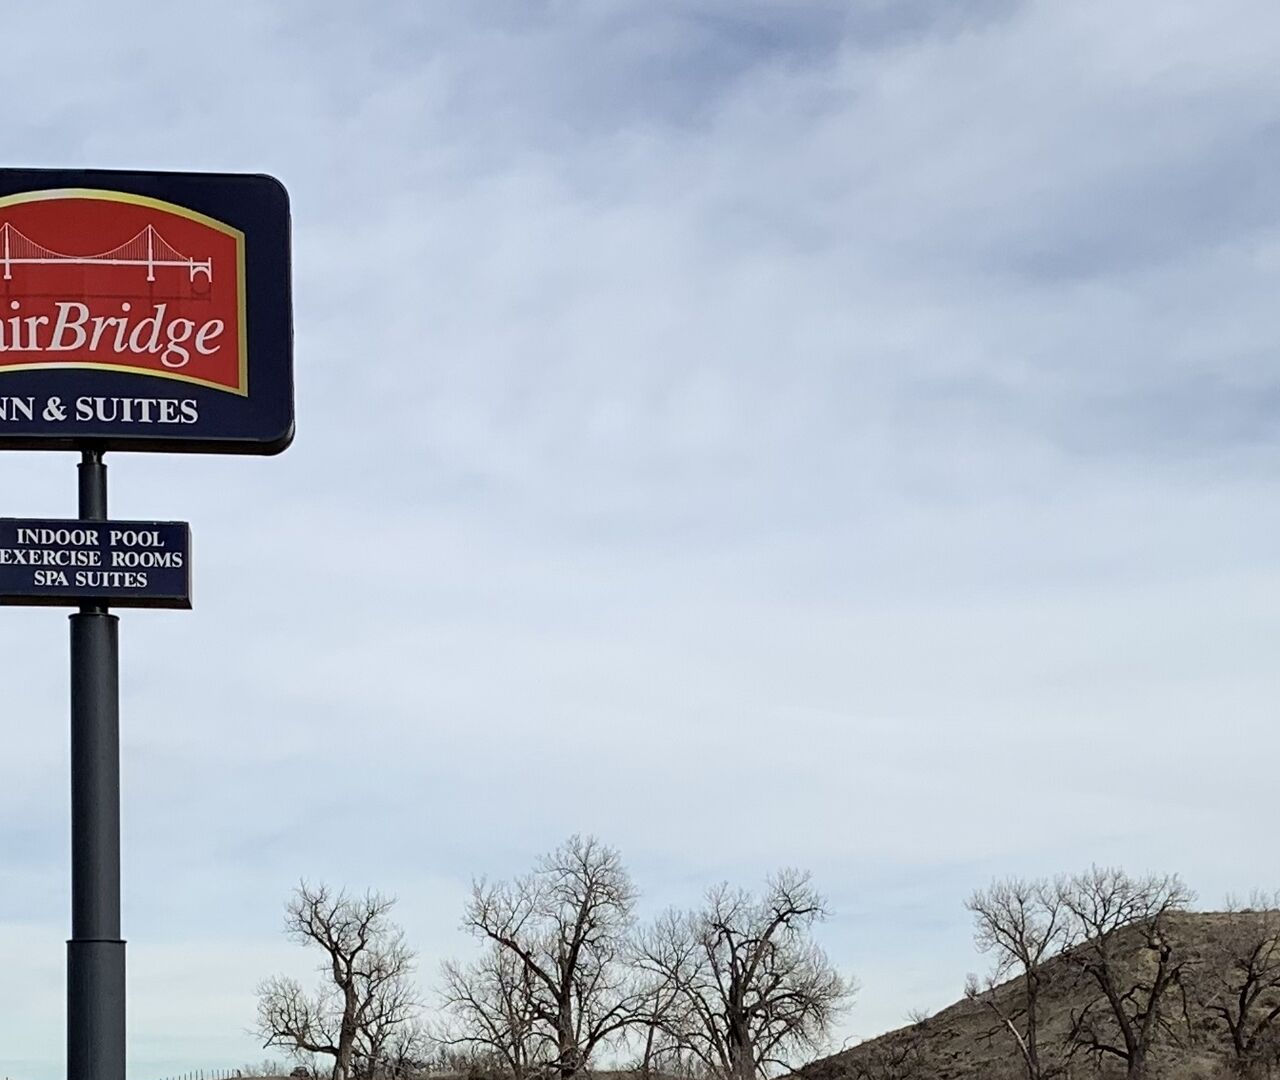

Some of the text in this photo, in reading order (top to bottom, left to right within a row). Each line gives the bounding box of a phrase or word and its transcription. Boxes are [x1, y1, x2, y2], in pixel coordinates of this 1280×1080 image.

[42, 397, 67, 422] &
[76, 397, 199, 424] SUITES
[17, 528, 165, 547] INDOOR POOL
[0, 548, 183, 568] EXERCISE ROOMS
[34, 570, 148, 587] SPA SUITES
